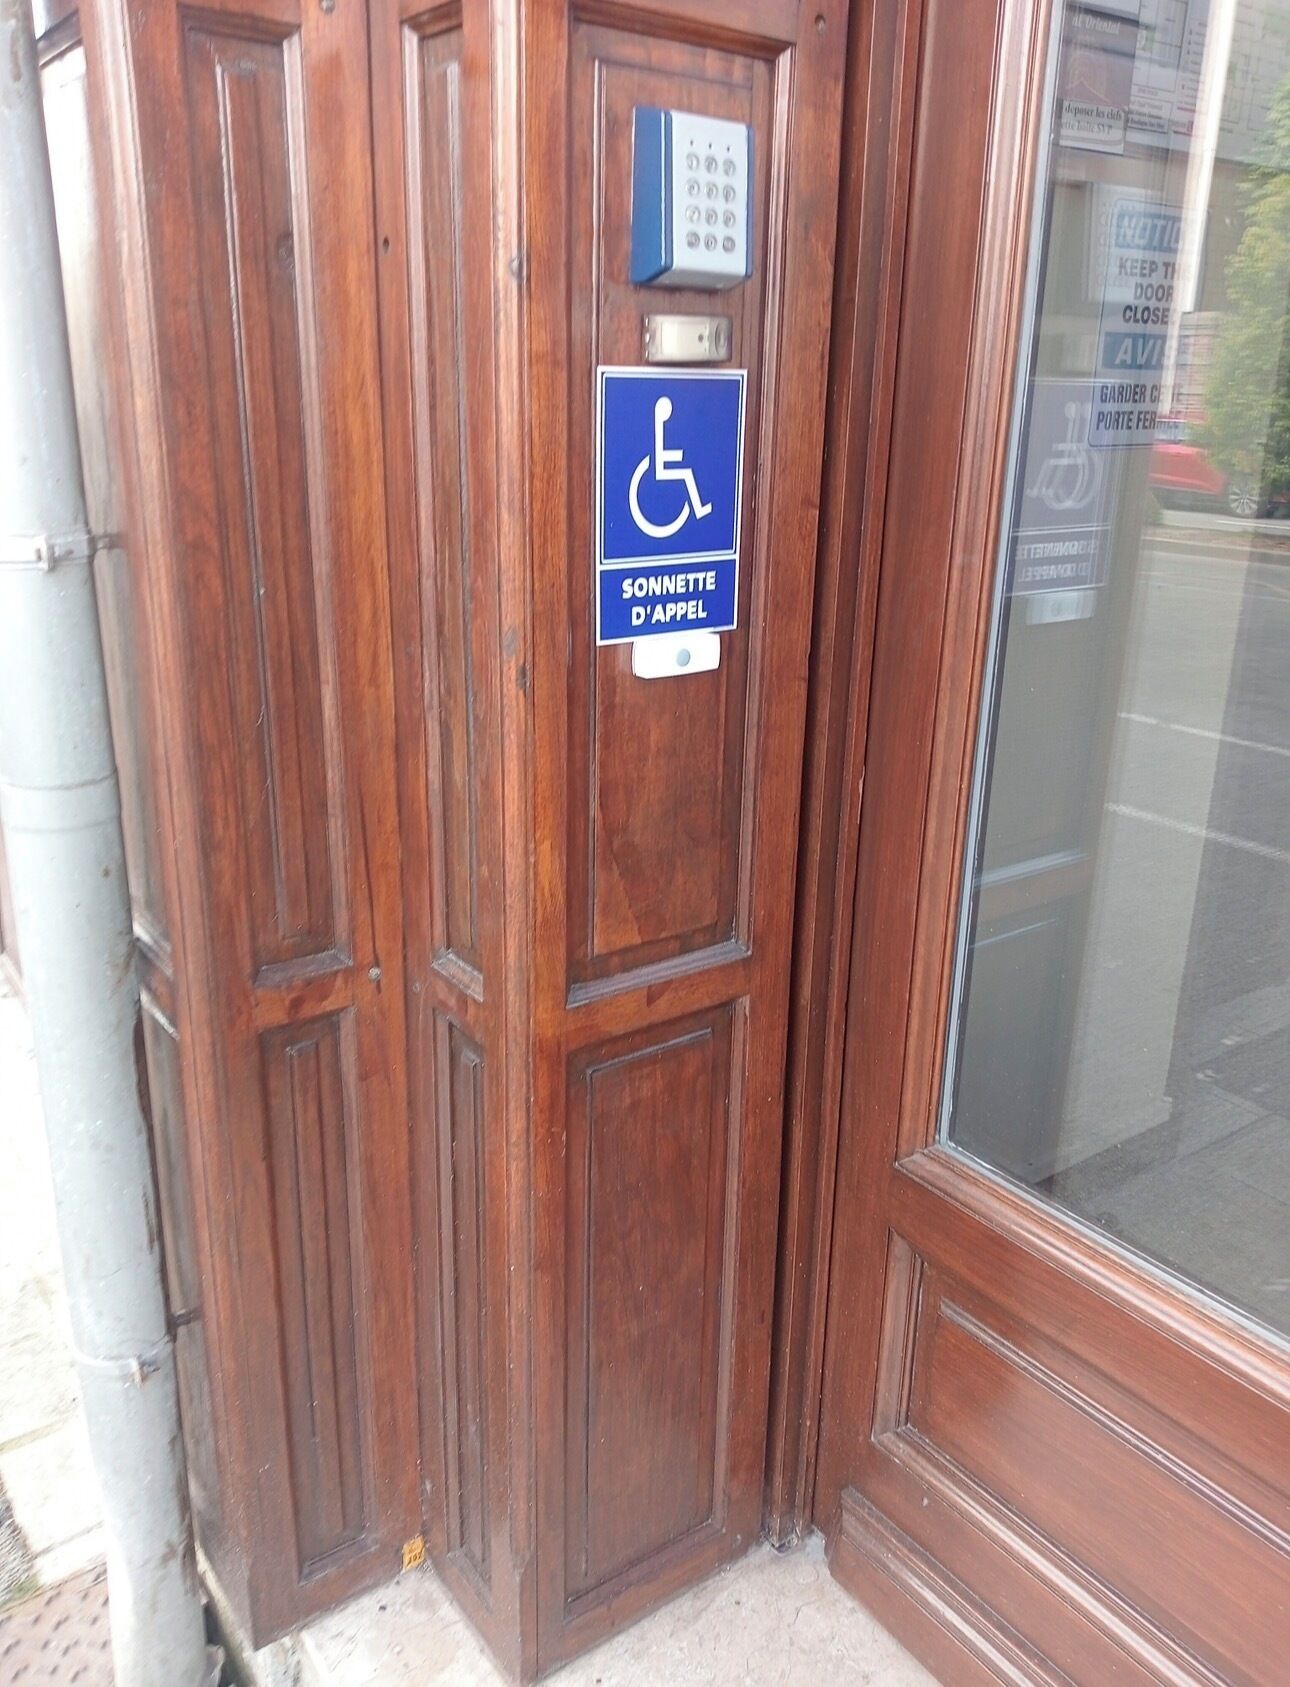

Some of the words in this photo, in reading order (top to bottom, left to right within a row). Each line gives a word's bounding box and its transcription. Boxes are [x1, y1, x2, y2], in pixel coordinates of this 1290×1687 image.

[1116, 214, 1181, 248] NOTIC
[1118, 257, 1158, 278] KEEP
[1133, 282, 1174, 303] DOOR
[1121, 304, 1172, 326] CLOSE
[1113, 337, 1163, 365] AVI
[1099, 384, 1146, 404] GARDER
[1095, 410, 1134, 431] PORTE
[622, 570, 717, 599] SONNETTE
[631, 599, 708, 627] D'APPEL
